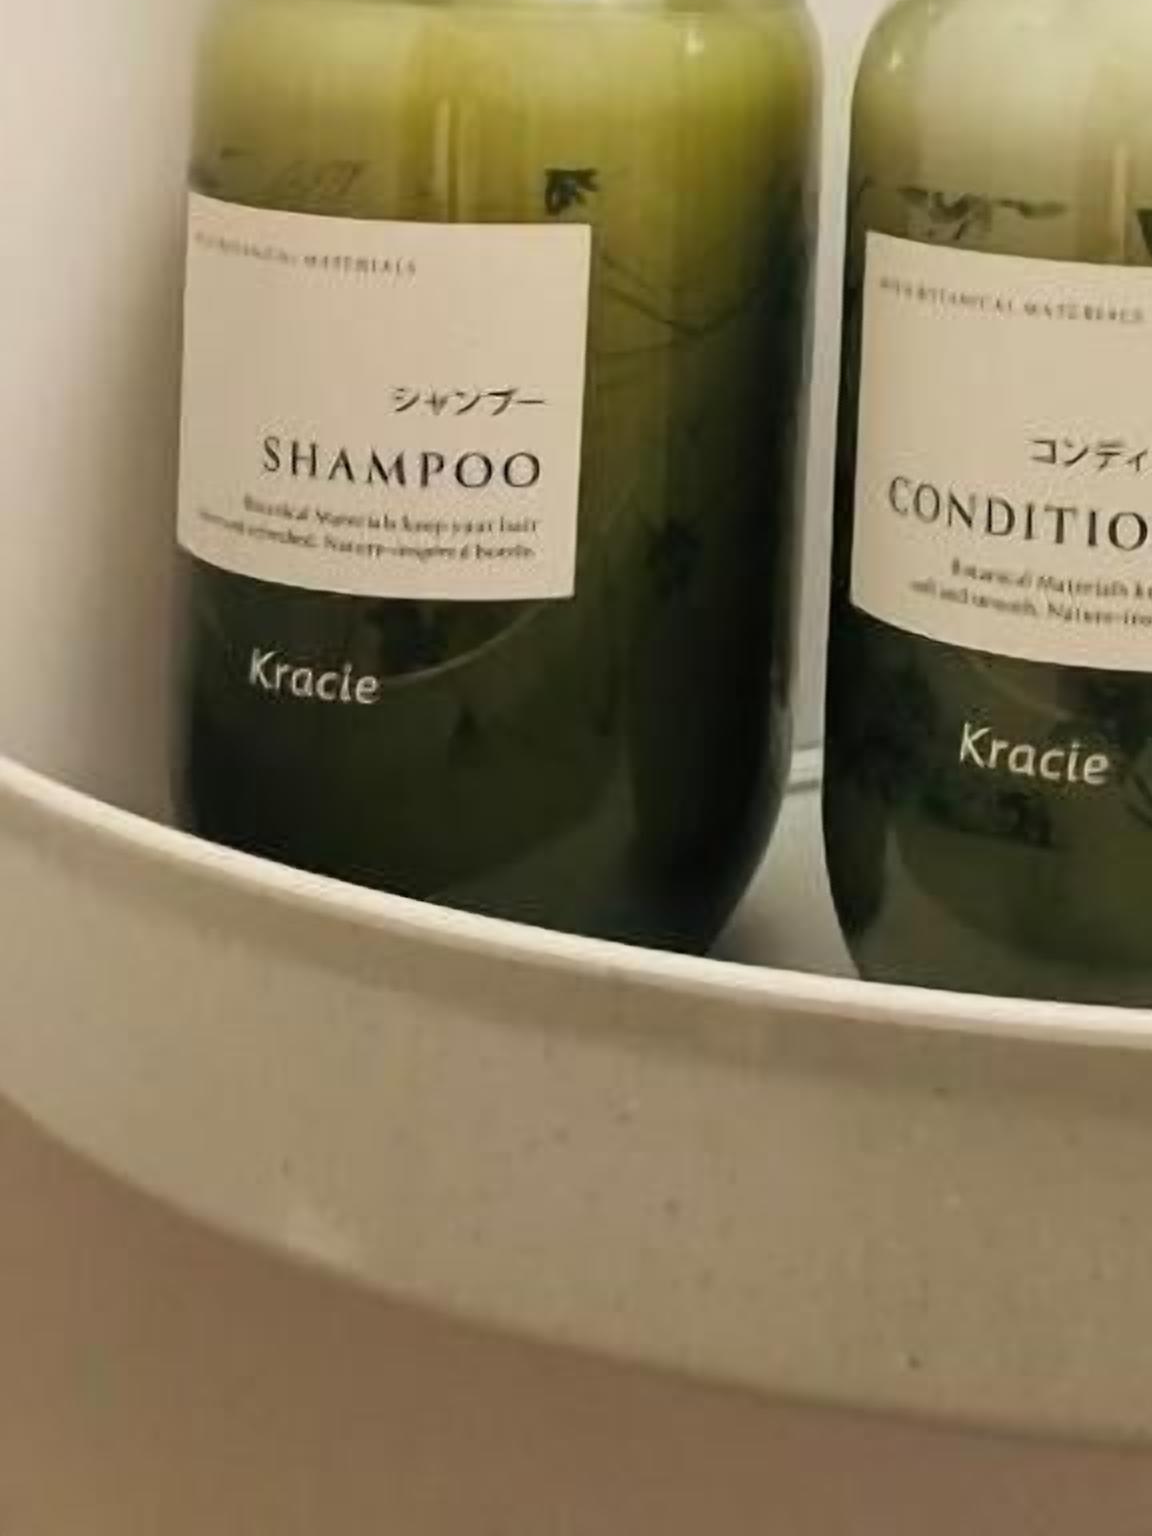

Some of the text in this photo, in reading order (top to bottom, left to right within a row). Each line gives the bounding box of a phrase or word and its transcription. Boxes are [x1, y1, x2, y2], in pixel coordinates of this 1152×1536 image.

[262, 434, 542, 489] SHAMPOO
[248, 646, 383, 706] Kracie
[957, 720, 1111, 787] Kracie
